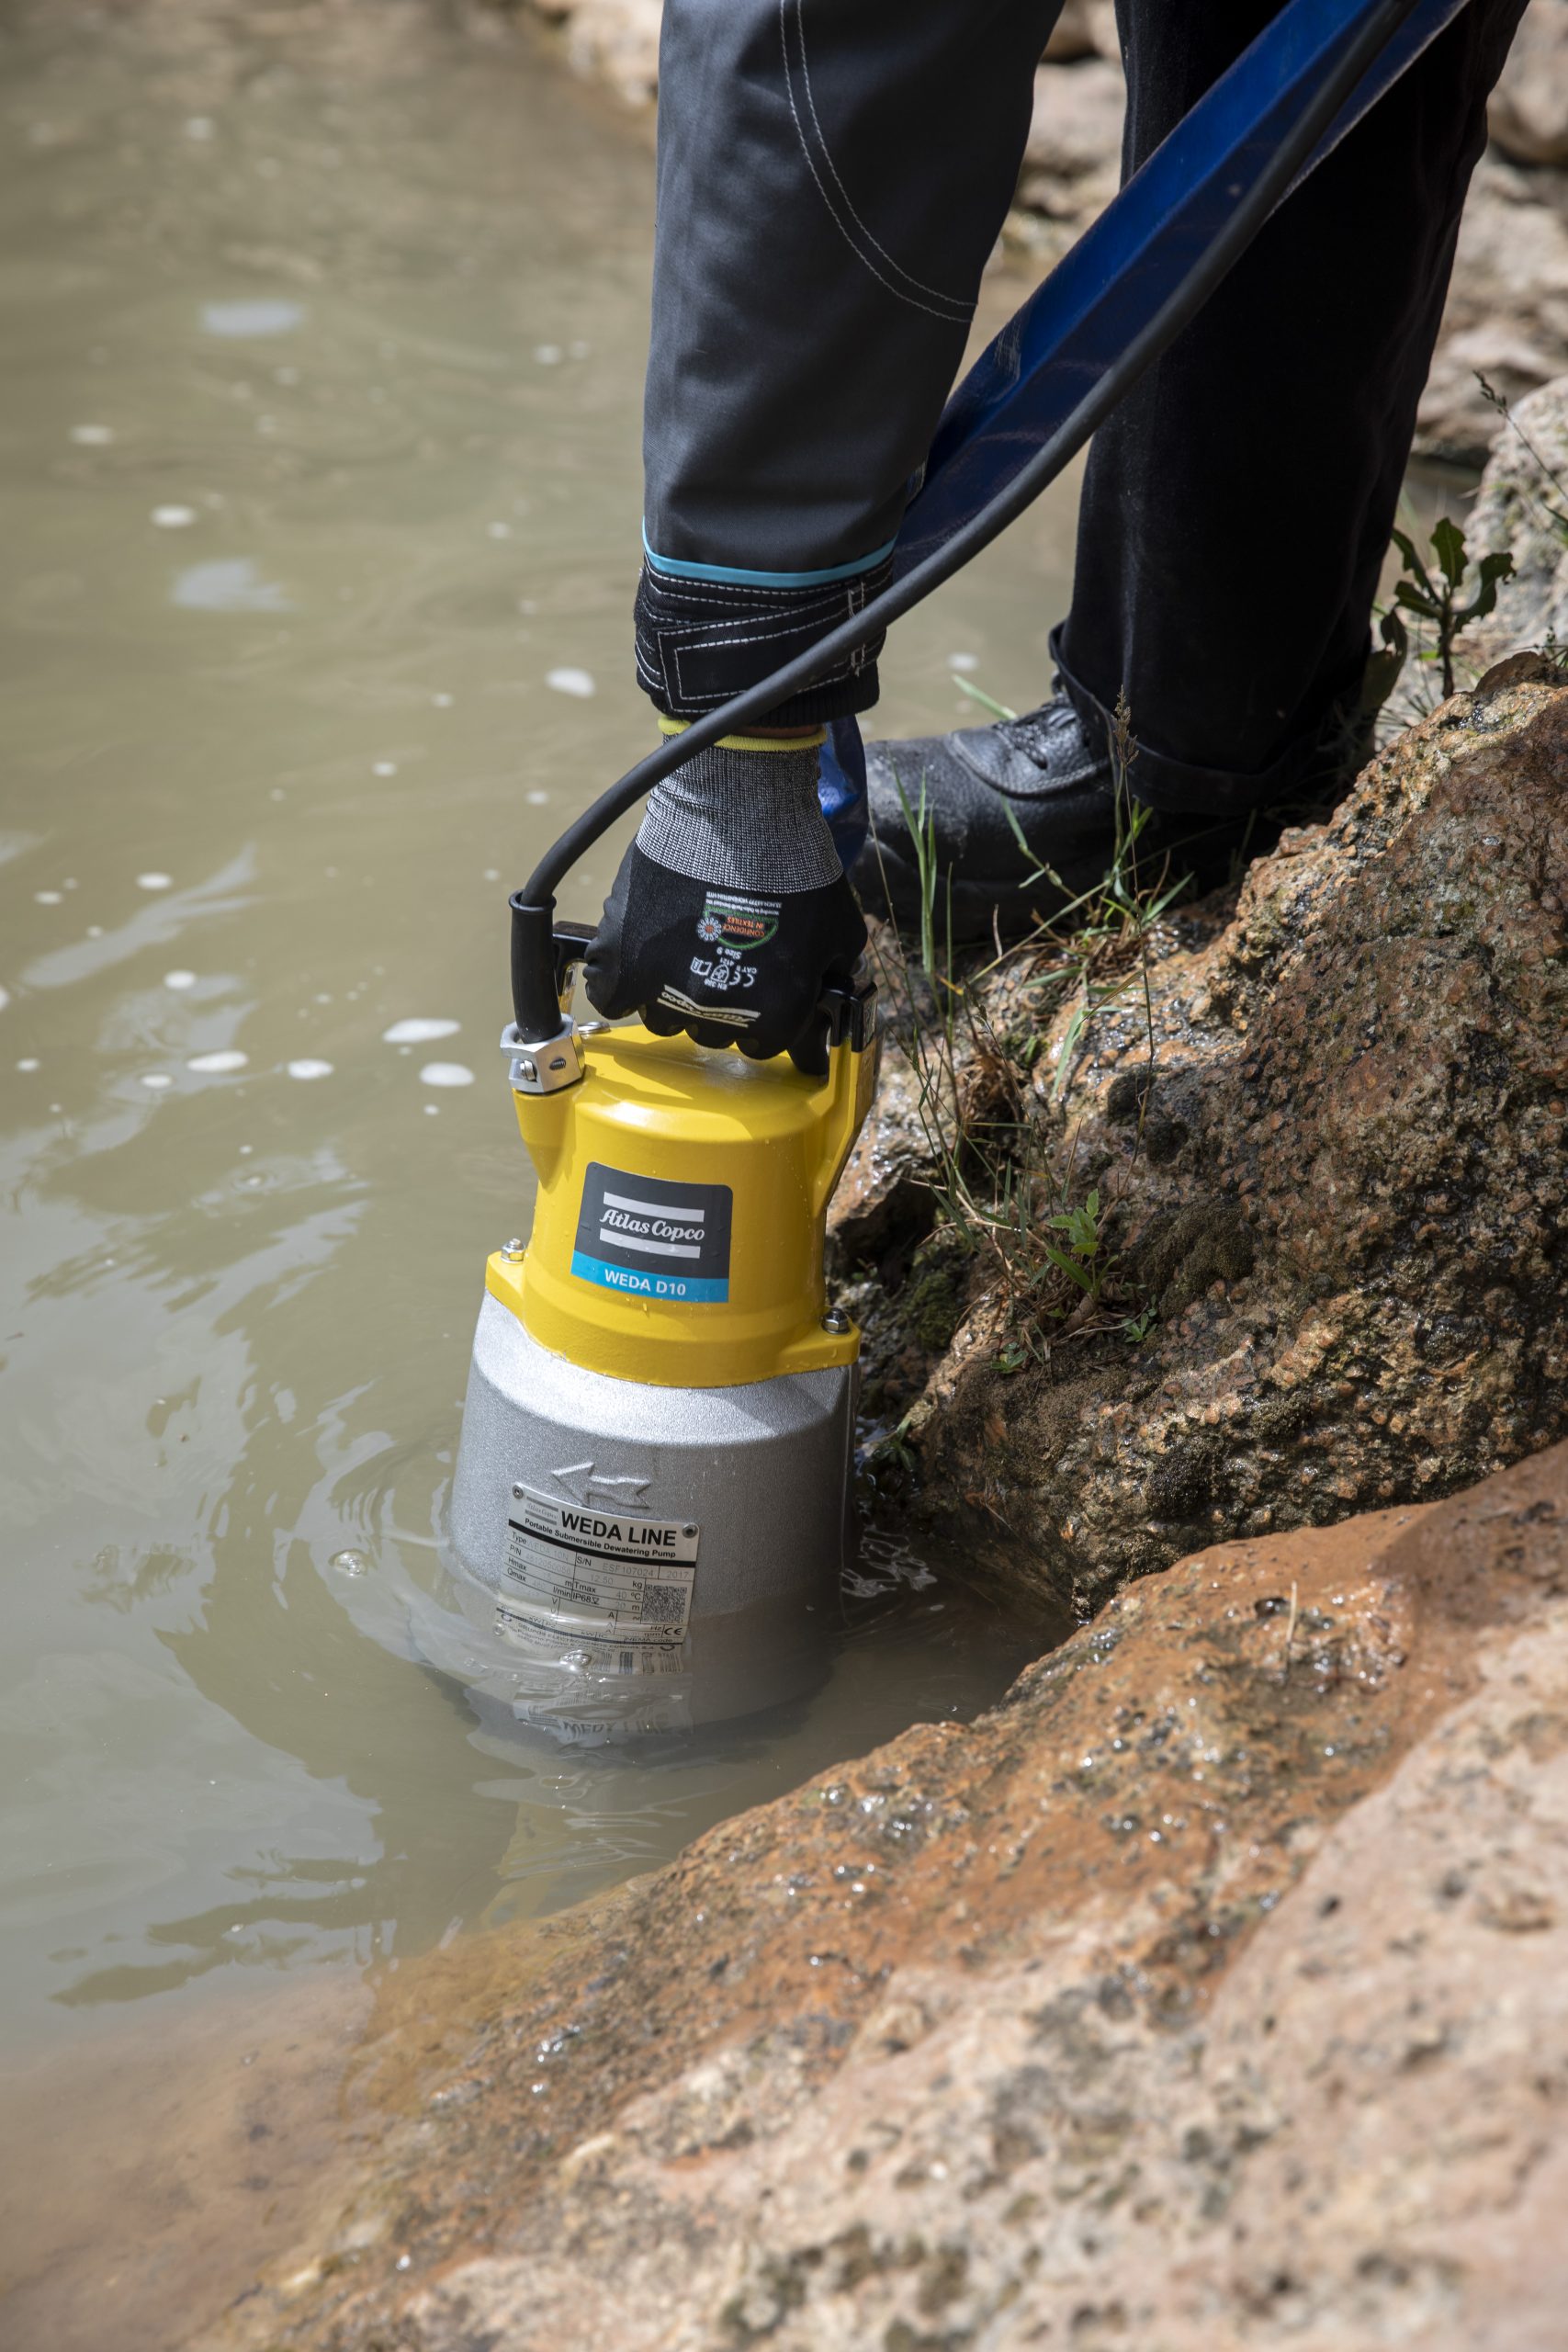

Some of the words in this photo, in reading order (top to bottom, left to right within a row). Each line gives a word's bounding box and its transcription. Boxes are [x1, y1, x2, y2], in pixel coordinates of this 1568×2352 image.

[727, 916, 754, 928] TEXTILES
[723, 923, 764, 937] CONFIDENCE
[725, 948, 742, 960] Size
[742, 966, 758, 974] CAT
[716, 982, 728, 990] EN
[599, 1208, 650, 1234] Atlas
[651, 1219, 705, 1241] Copco
[604, 1268, 651, 1292] WEDA
[656, 1281, 686, 1296] D10
[561, 1510, 622, 1541] WEDA
[628, 1526, 677, 1547] LINE
[512, 1530, 527, 1544] Type
[525, 1518, 553, 1534] Portable
[554, 1529, 602, 1550] Submersible
[604, 1543, 650, 1557] Dewatering
[651, 1548, 676, 1559] Pump
[509, 1544, 522, 1556] P/N
[508, 1557, 527, 1571] Hmax
[576, 1555, 592, 1567] S/N
[667, 1570, 689, 1579] 2017
[507, 1567, 526, 1582] Qmax
[552, 1585, 571, 1598] l/min
[575, 1581, 597, 1594] Tmax
[632, 1580, 643, 1590] kg
[551, 1596, 558, 1605] V
[572, 1591, 592, 1604] IP68
[631, 1603, 641, 1611] m
[608, 1611, 615, 1620] A
